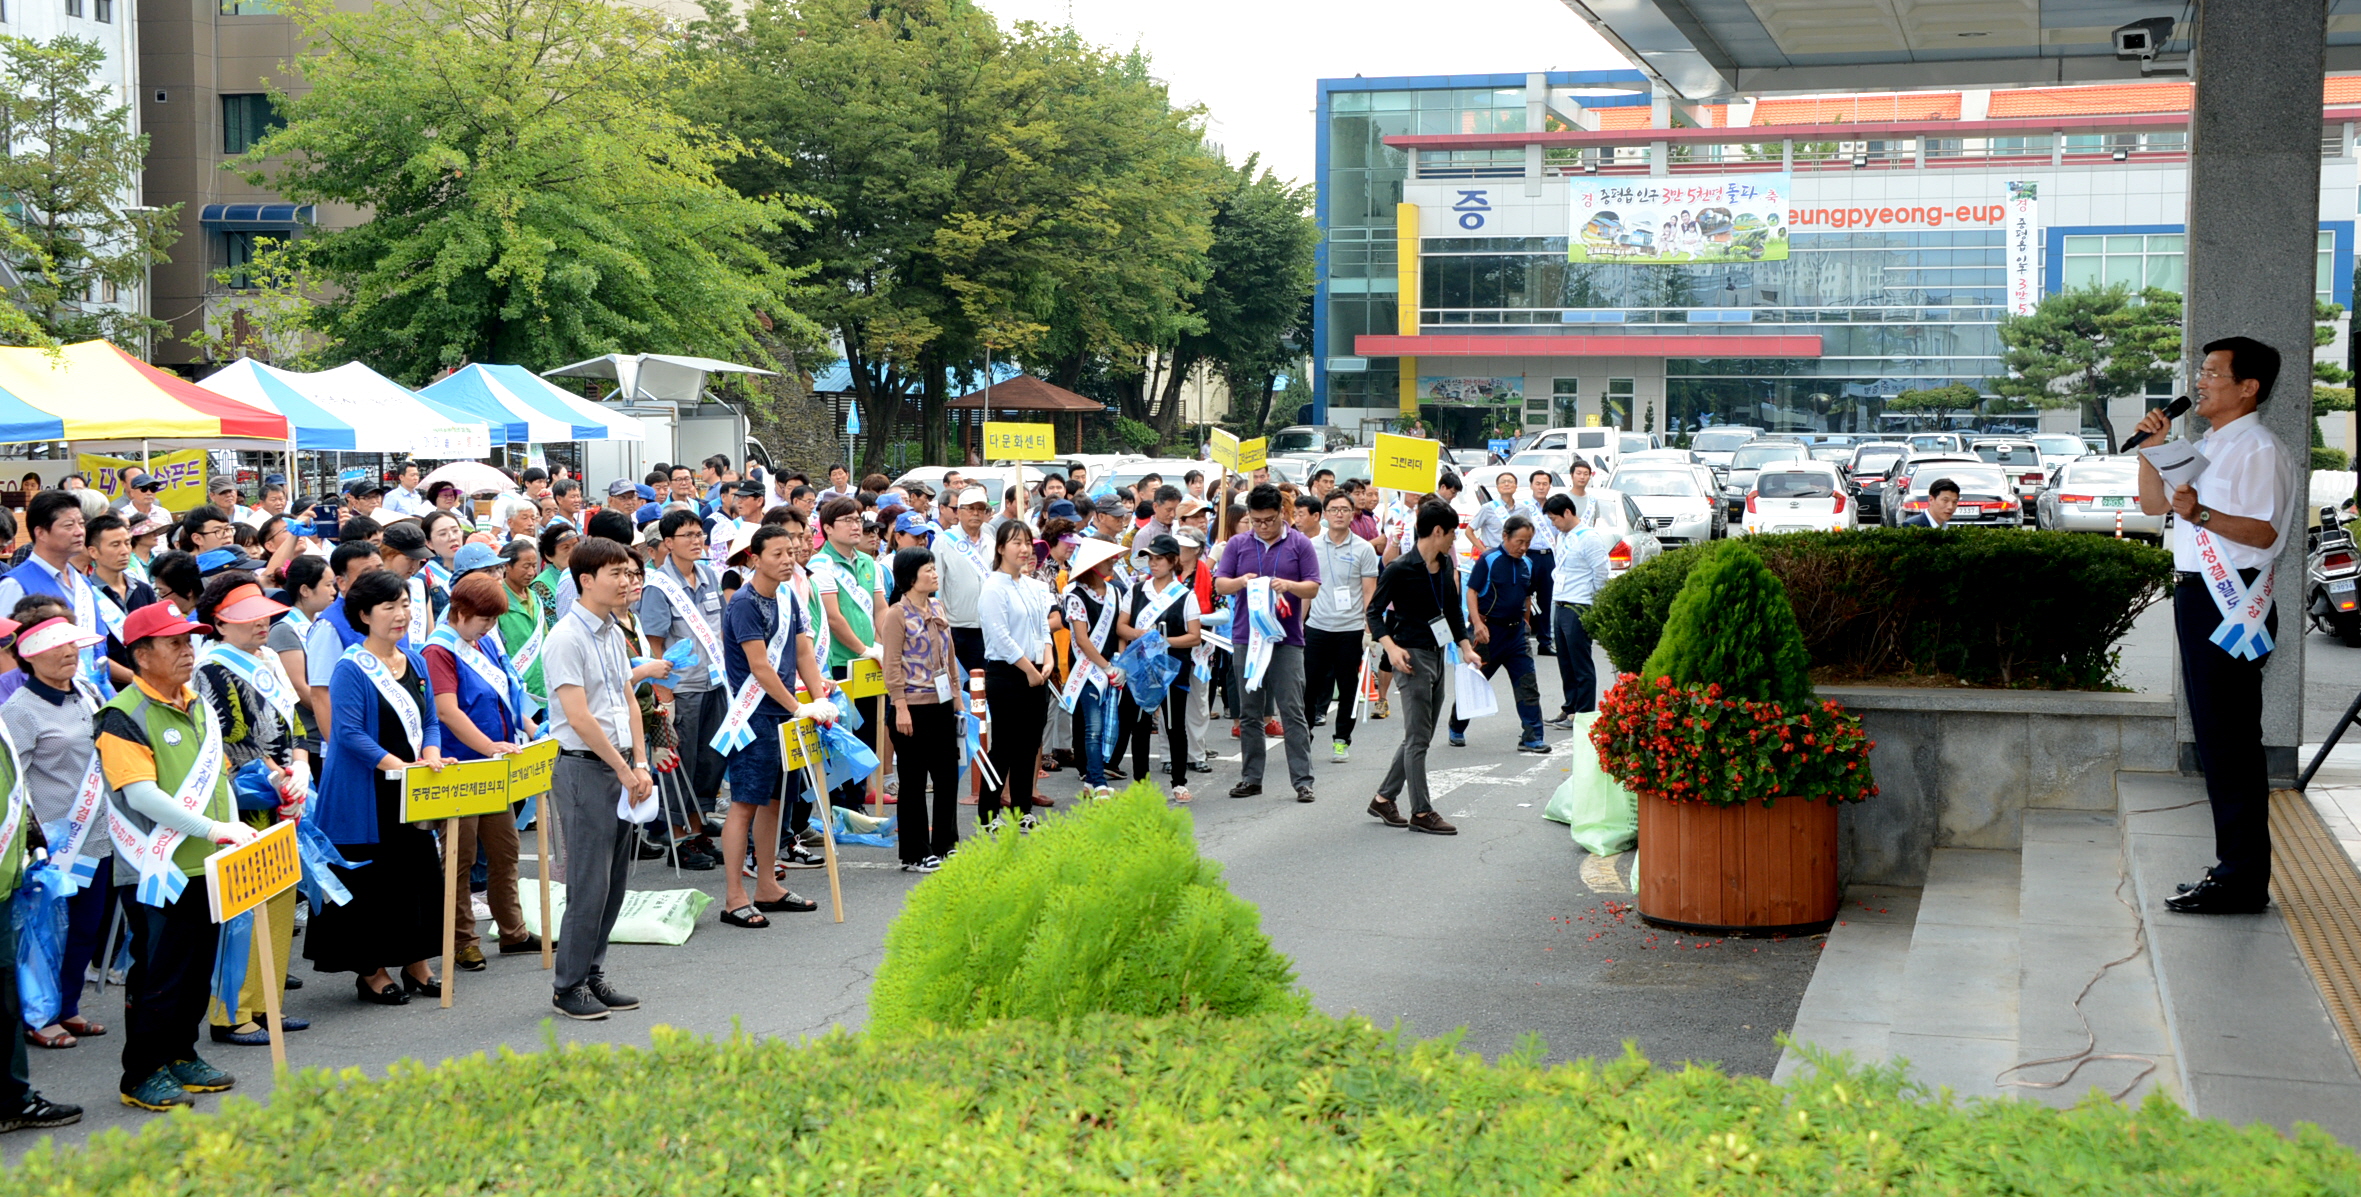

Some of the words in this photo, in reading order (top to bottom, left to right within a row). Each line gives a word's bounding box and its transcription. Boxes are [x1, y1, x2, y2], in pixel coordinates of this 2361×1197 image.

[1582, 193, 1593, 207] 경
[1600, 187, 1633, 205] 증평읍
[1637, 187, 1659, 203] 인구
[1662, 188, 1684, 204] 3만
[1687, 187, 1723, 203] 5천명
[1725, 182, 1758, 204] 돌파
[1765, 189, 1779, 203] 축
[1452, 190, 1492, 230] 증
[989, 434, 1046, 449] 다문화센터
[1390, 456, 1423, 471] 그린리더
[865, 671, 883, 683] 증평군
[412, 779, 505, 802] 증평군여성단체협의회
